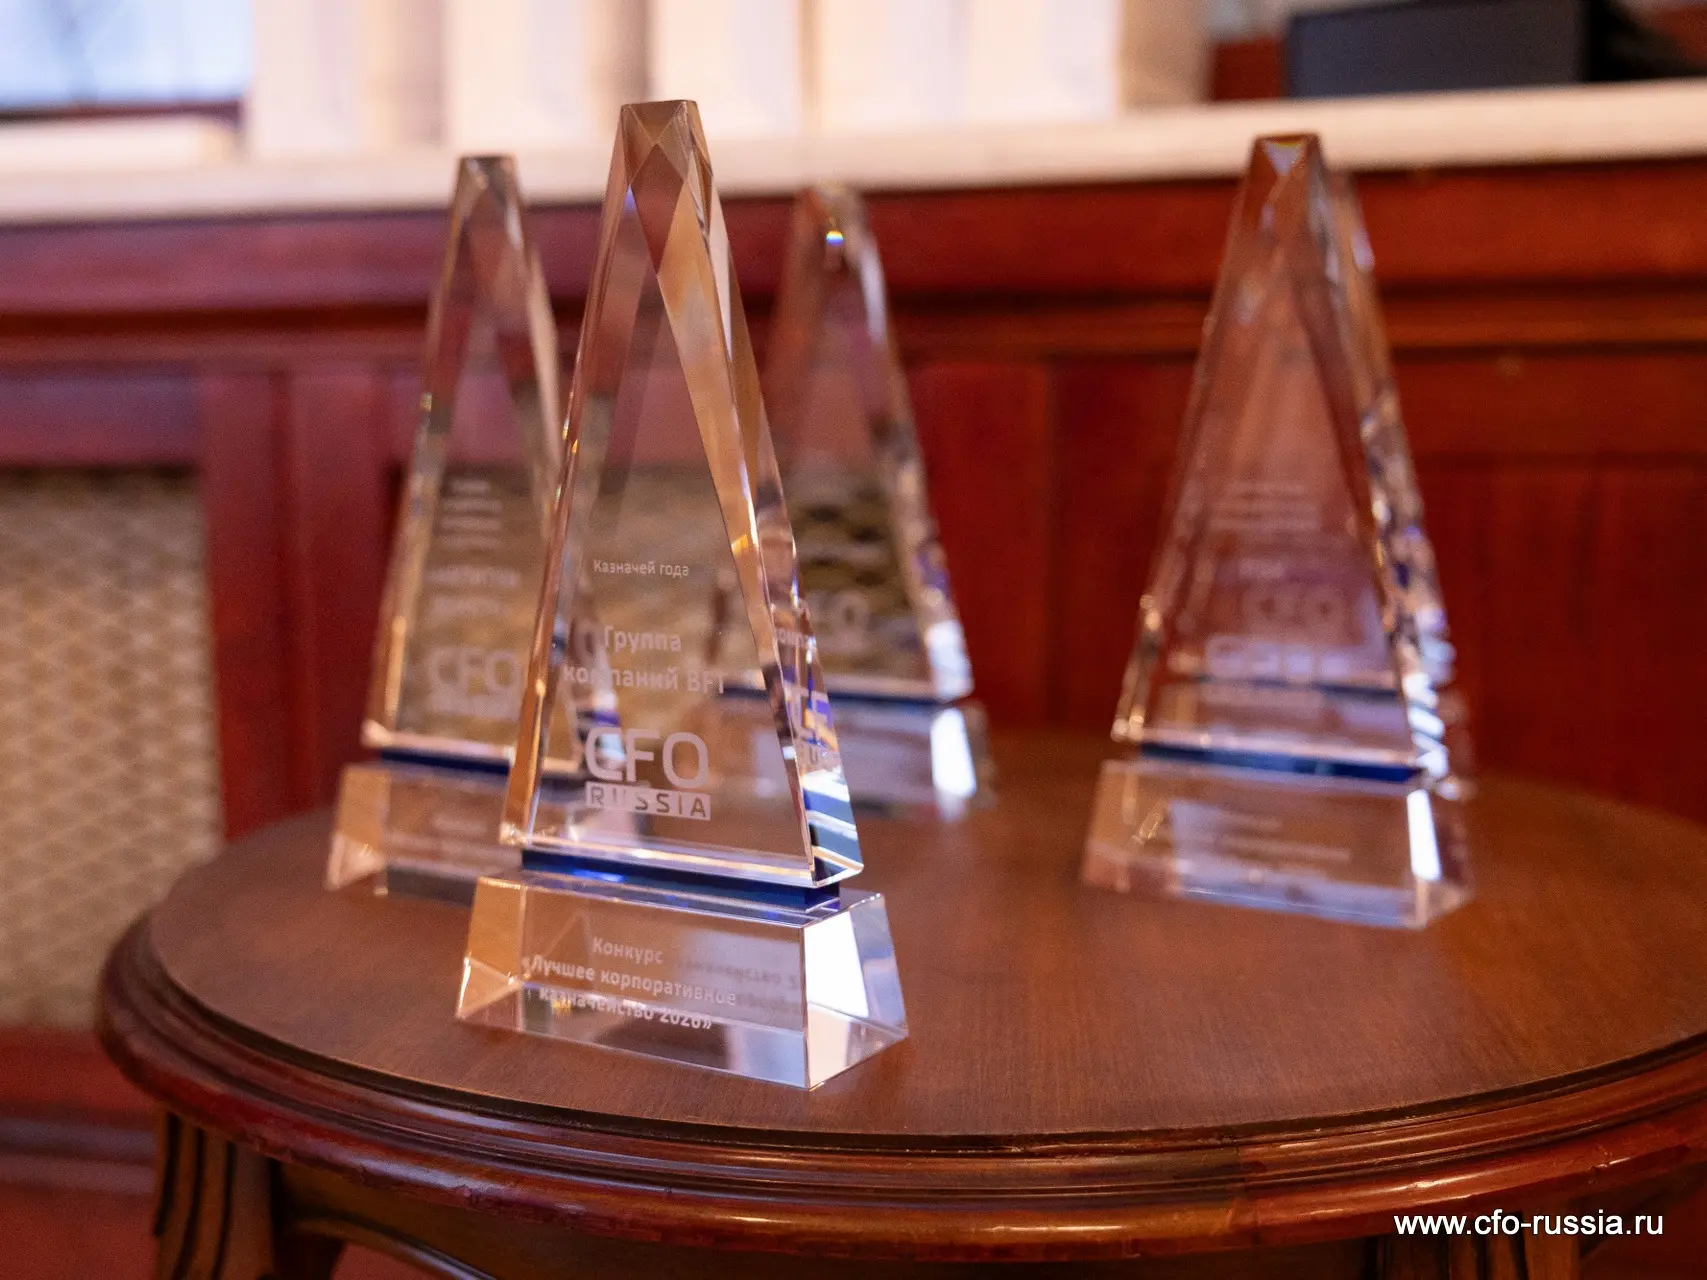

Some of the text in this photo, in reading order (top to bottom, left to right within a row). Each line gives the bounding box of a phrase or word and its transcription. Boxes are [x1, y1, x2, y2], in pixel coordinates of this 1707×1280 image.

[593, 559, 689, 579] Казначей года
[604, 624, 682, 653] Группа
[562, 664, 679, 692] копаний
[585, 727, 709, 789] CFO
[592, 936, 664, 965] Конкурс
[601, 970, 737, 1006] корпоративное
